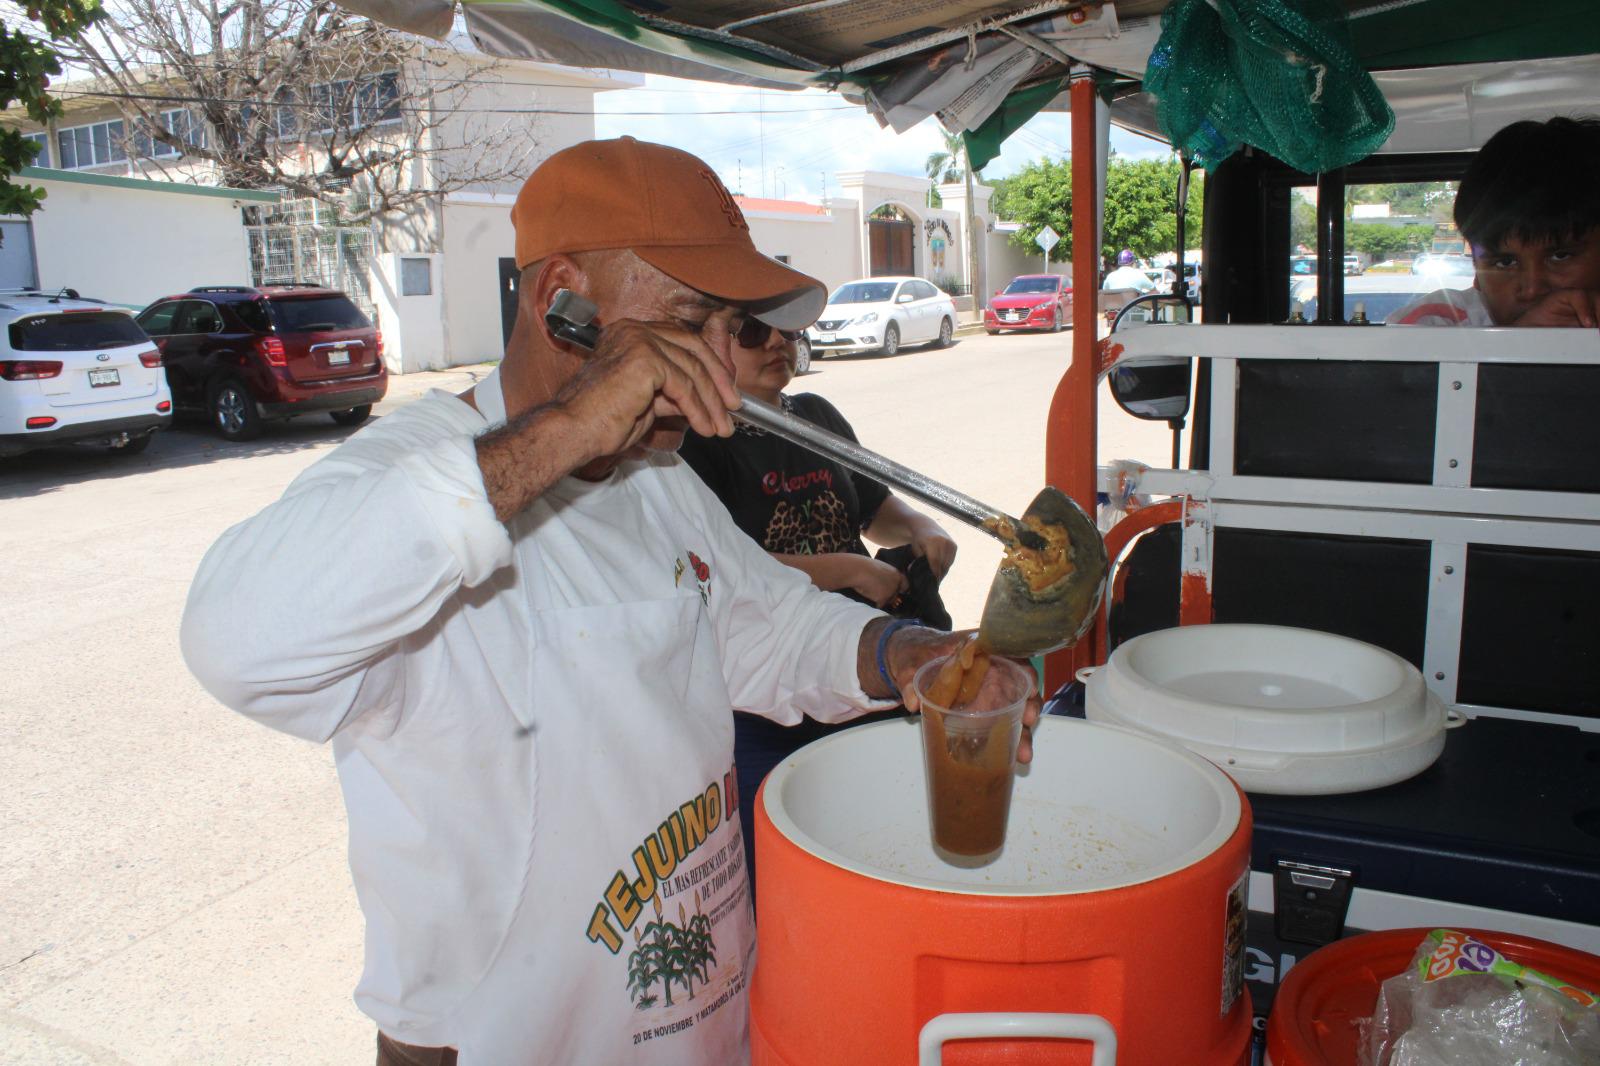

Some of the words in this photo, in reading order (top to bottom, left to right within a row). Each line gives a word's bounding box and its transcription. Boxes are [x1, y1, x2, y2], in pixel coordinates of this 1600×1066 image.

[762, 468, 832, 496] Cherry
[586, 782, 722, 955] TEJUINO
[661, 881, 674, 899] EL
[674, 872, 691, 895] MAS
[690, 846, 727, 887] REFRESCANTE
[701, 883, 710, 902] DE
[712, 869, 727, 895] TODO
[1431, 935, 1458, 977] 100
[633, 1033, 641, 1046] 20
[643, 1028, 653, 1041] DE
[653, 1016, 694, 1038] NOVIEMBRE
[695, 1011, 701, 1023] Y
[700, 991, 730, 1020] MATAMOROS
